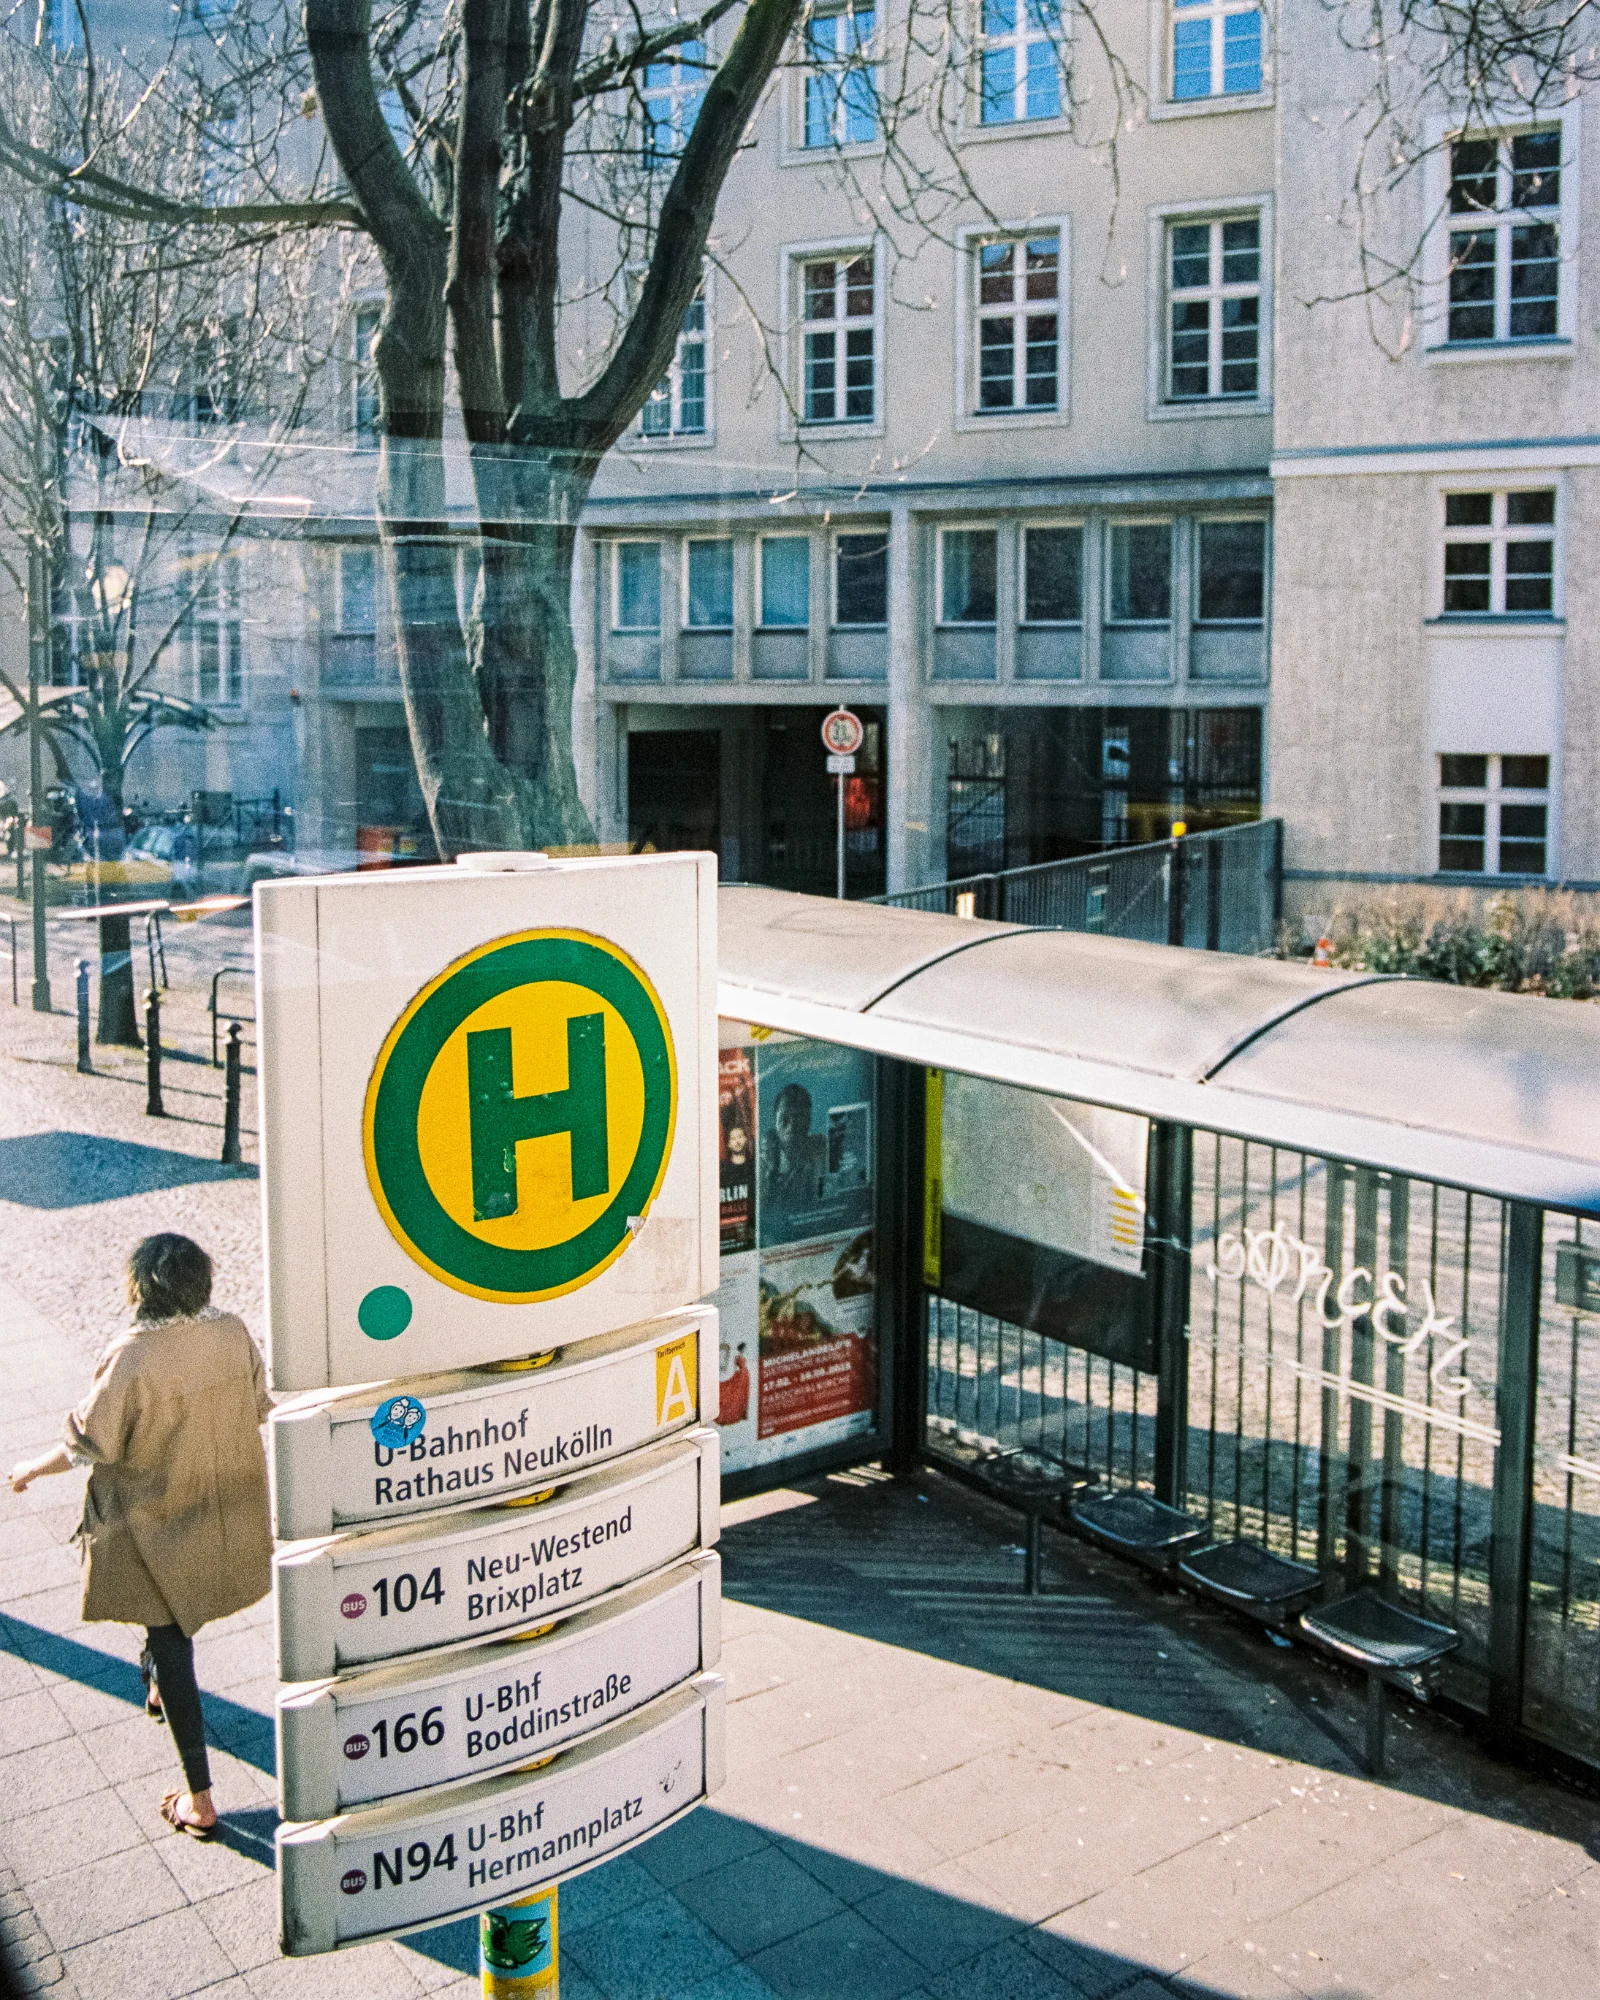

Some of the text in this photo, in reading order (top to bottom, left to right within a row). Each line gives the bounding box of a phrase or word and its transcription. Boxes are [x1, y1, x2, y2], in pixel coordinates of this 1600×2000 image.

[466, 1011, 610, 1223] H
[658, 1355, 696, 1428] A
[374, 1408, 529, 1467] U-Bahnhof
[375, 1424, 613, 1505] Rathaus Neukölln
[467, 1505, 633, 1586] Neu-Westend
[341, 1566, 446, 1617] BUS 104
[467, 1566, 583, 1621] Brixplatz
[465, 1670, 542, 1722] U-Bhf
[466, 1672, 632, 1758] Boddinstraße
[345, 1705, 446, 1758] BUS 166
[467, 1801, 545, 1851] U-Bhf
[468, 1796, 644, 1888] Hermannplatz
[341, 1833, 458, 1890] BUS N94
